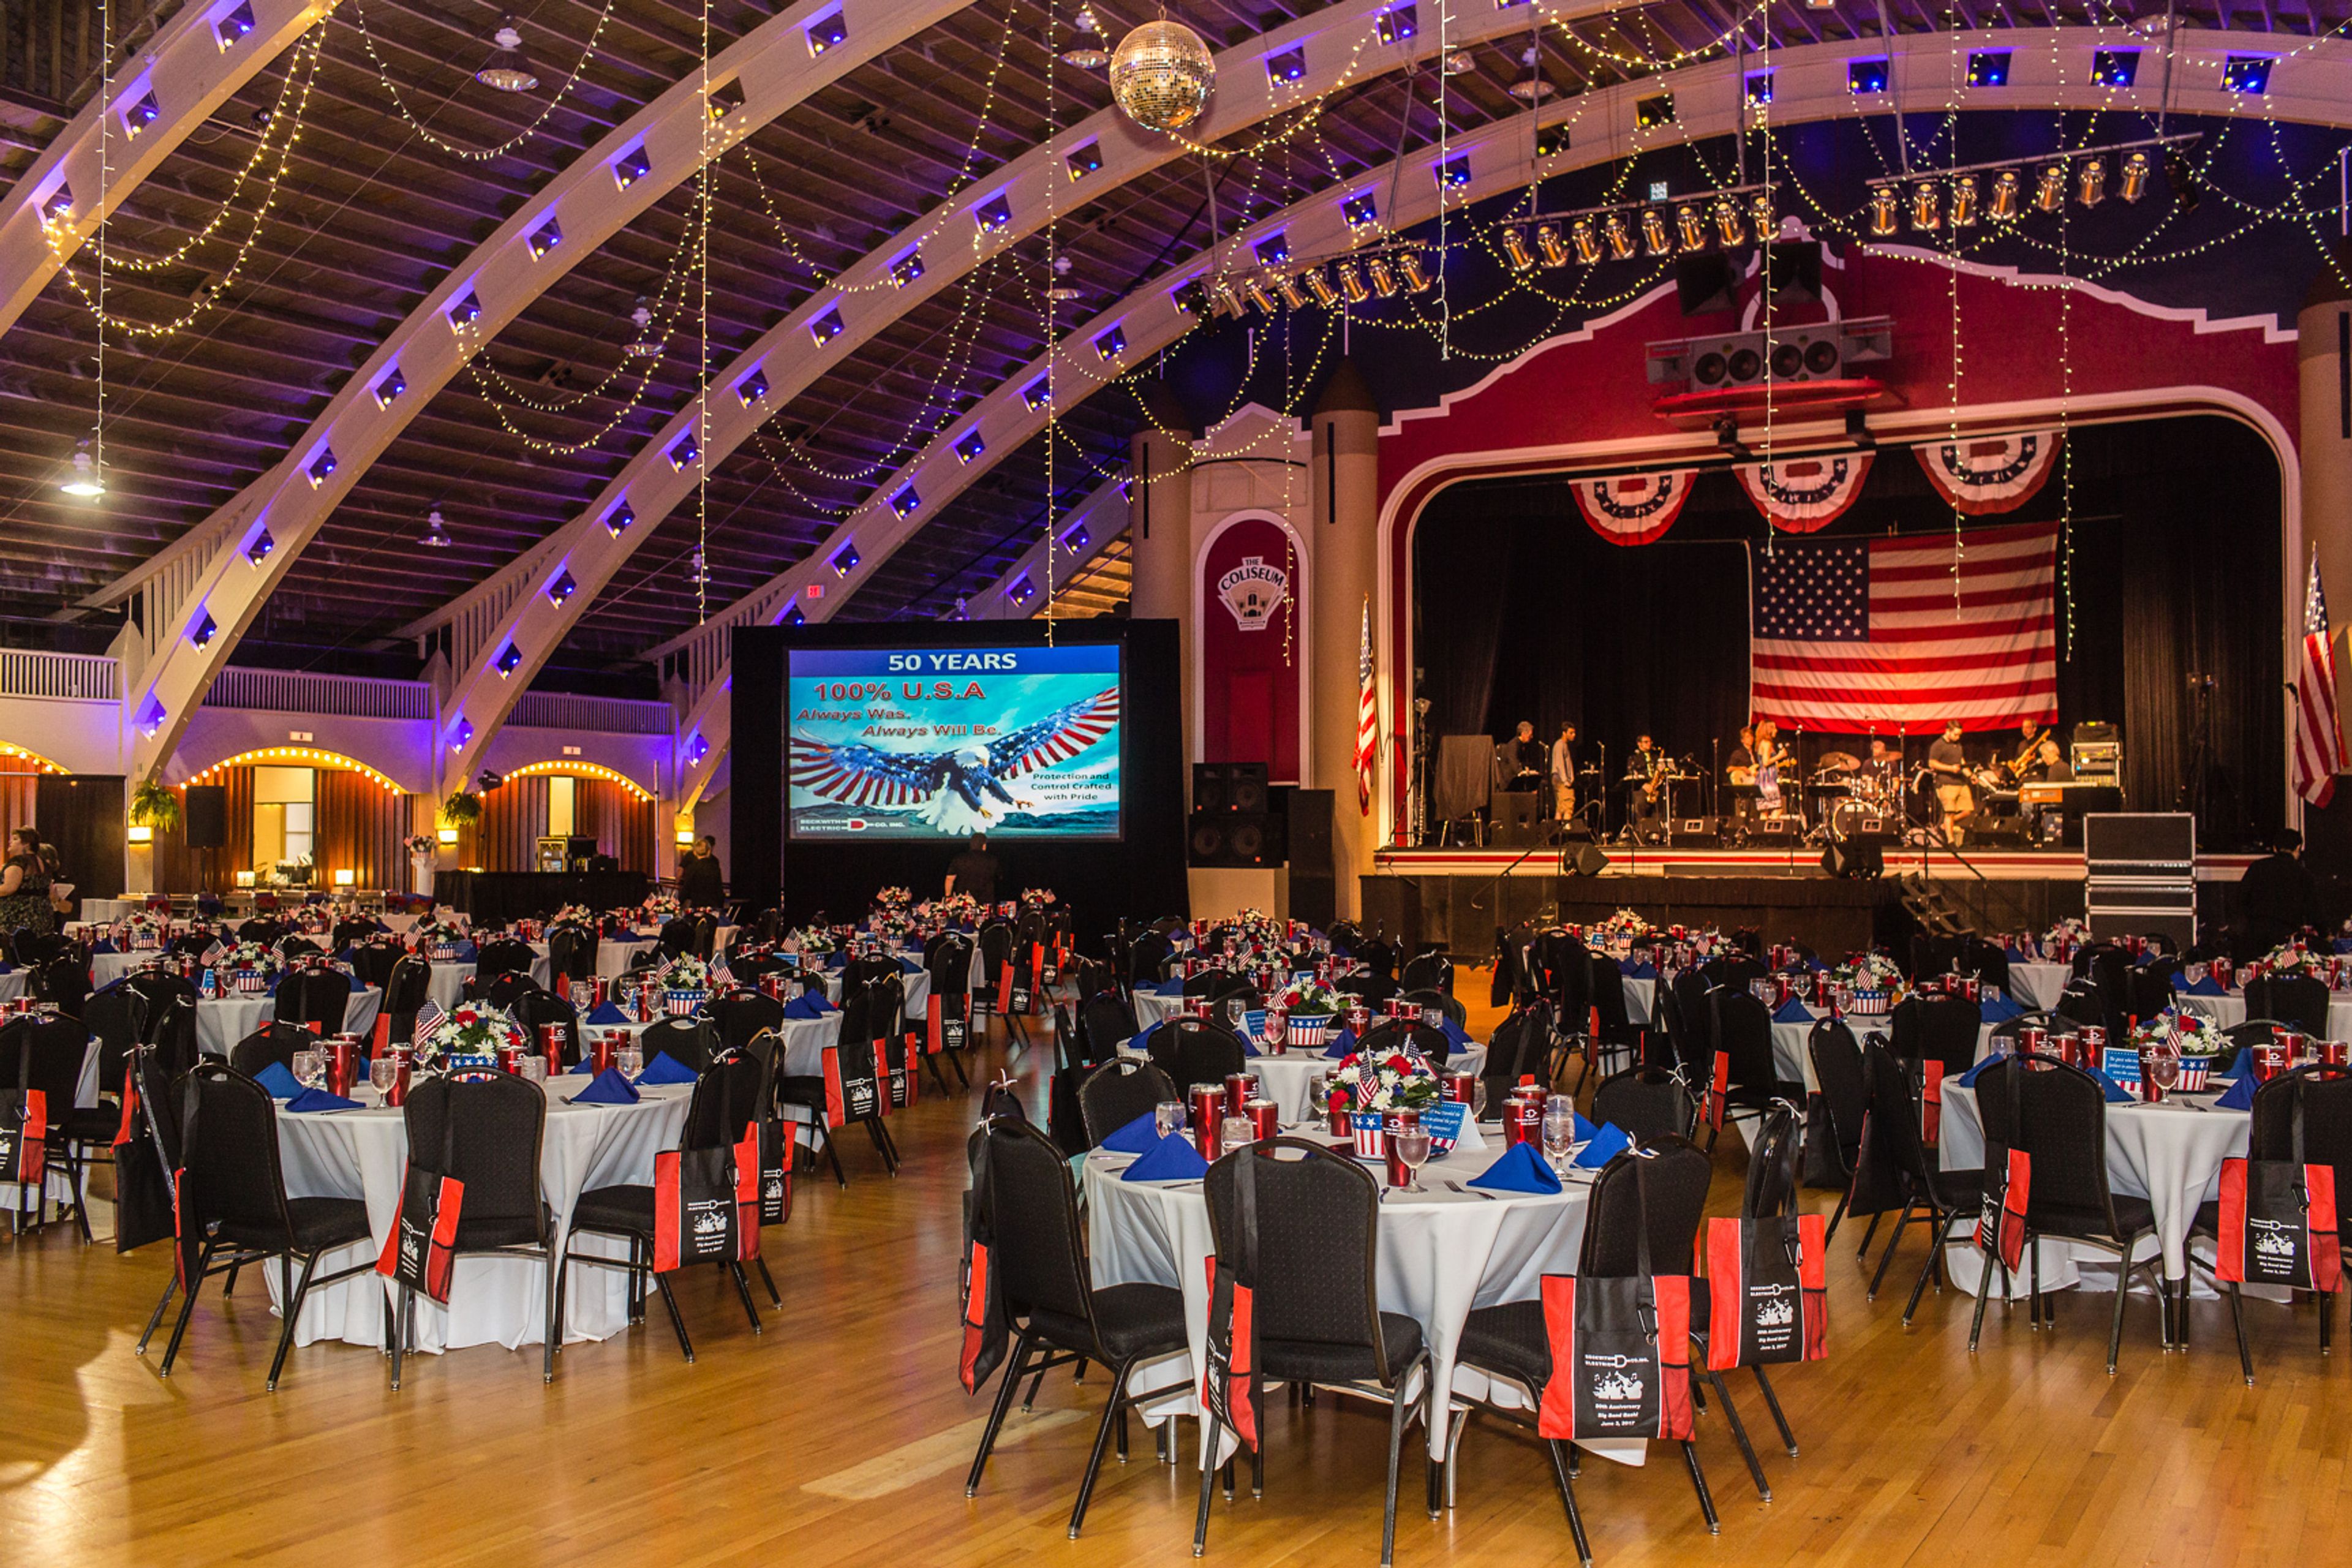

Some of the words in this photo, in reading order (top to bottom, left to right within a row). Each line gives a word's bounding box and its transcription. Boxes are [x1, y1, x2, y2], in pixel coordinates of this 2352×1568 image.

[1221, 567, 1284, 590] COLISEUM
[889, 654, 922, 671] 50
[929, 653, 1017, 670] YEARS
[813, 682, 892, 701] 100%
[902, 680, 986, 700] U.S.A
[796, 708, 862, 721] Always
[866, 707, 911, 720] Was.
[861, 725, 927, 737] Always
[935, 724, 967, 736] Will
[973, 724, 1002, 736] Be.
[1071, 782, 1112, 791] Crafted
